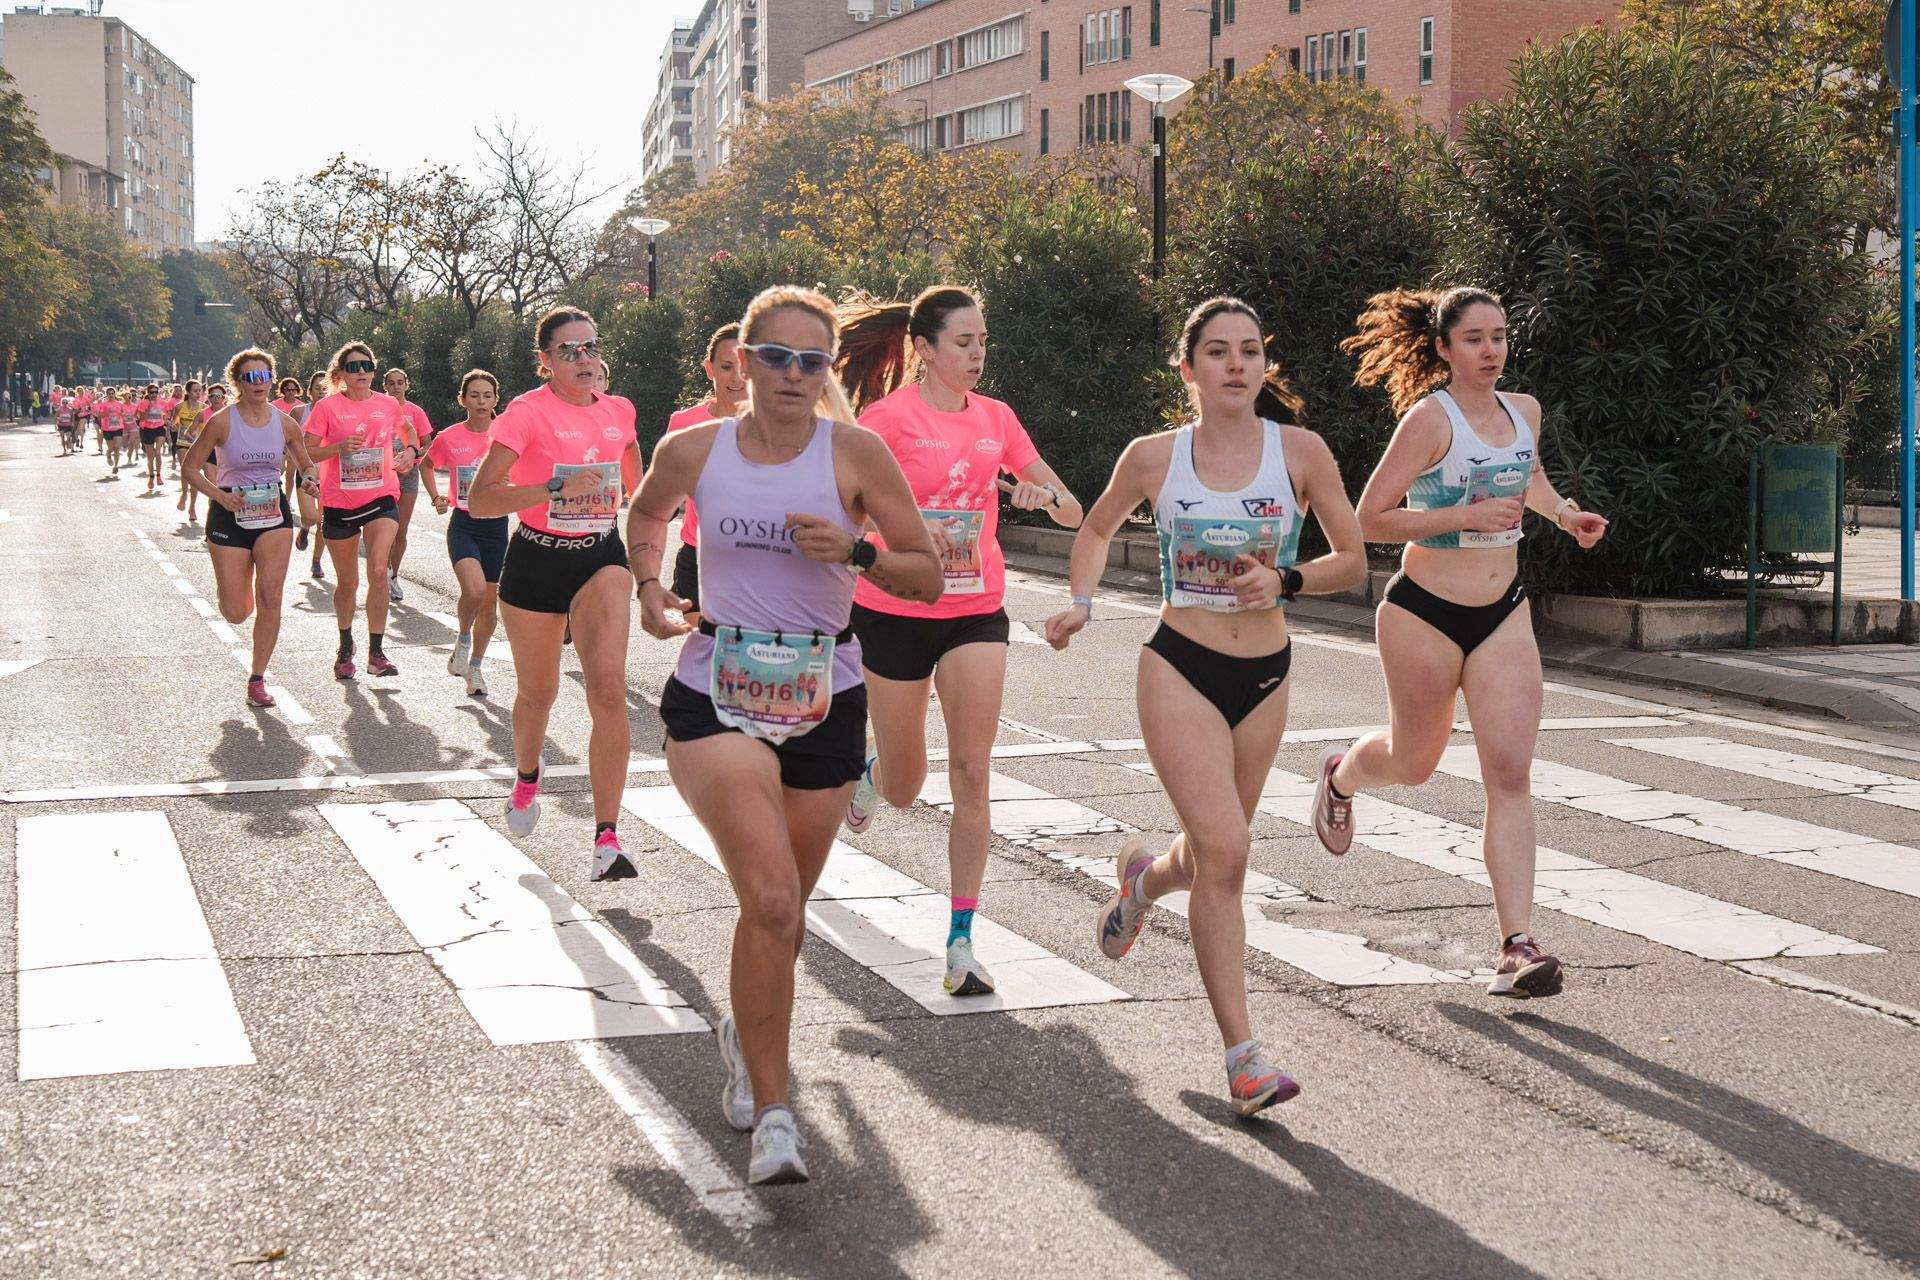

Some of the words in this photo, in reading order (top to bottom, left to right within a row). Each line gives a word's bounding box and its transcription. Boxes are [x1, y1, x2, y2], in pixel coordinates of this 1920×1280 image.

[915, 438, 950, 450] OYSHO
[242, 452, 275, 461] OYSHO
[518, 525, 554, 548] NIKE
[555, 536, 595, 550] PRO
[1470, 535, 1497, 543] OYSHO
[735, 541, 770, 551] RUNNING
[772, 545, 792, 554] CLUB
[1207, 557, 1246, 576] 016
[749, 681, 792, 700] 016
